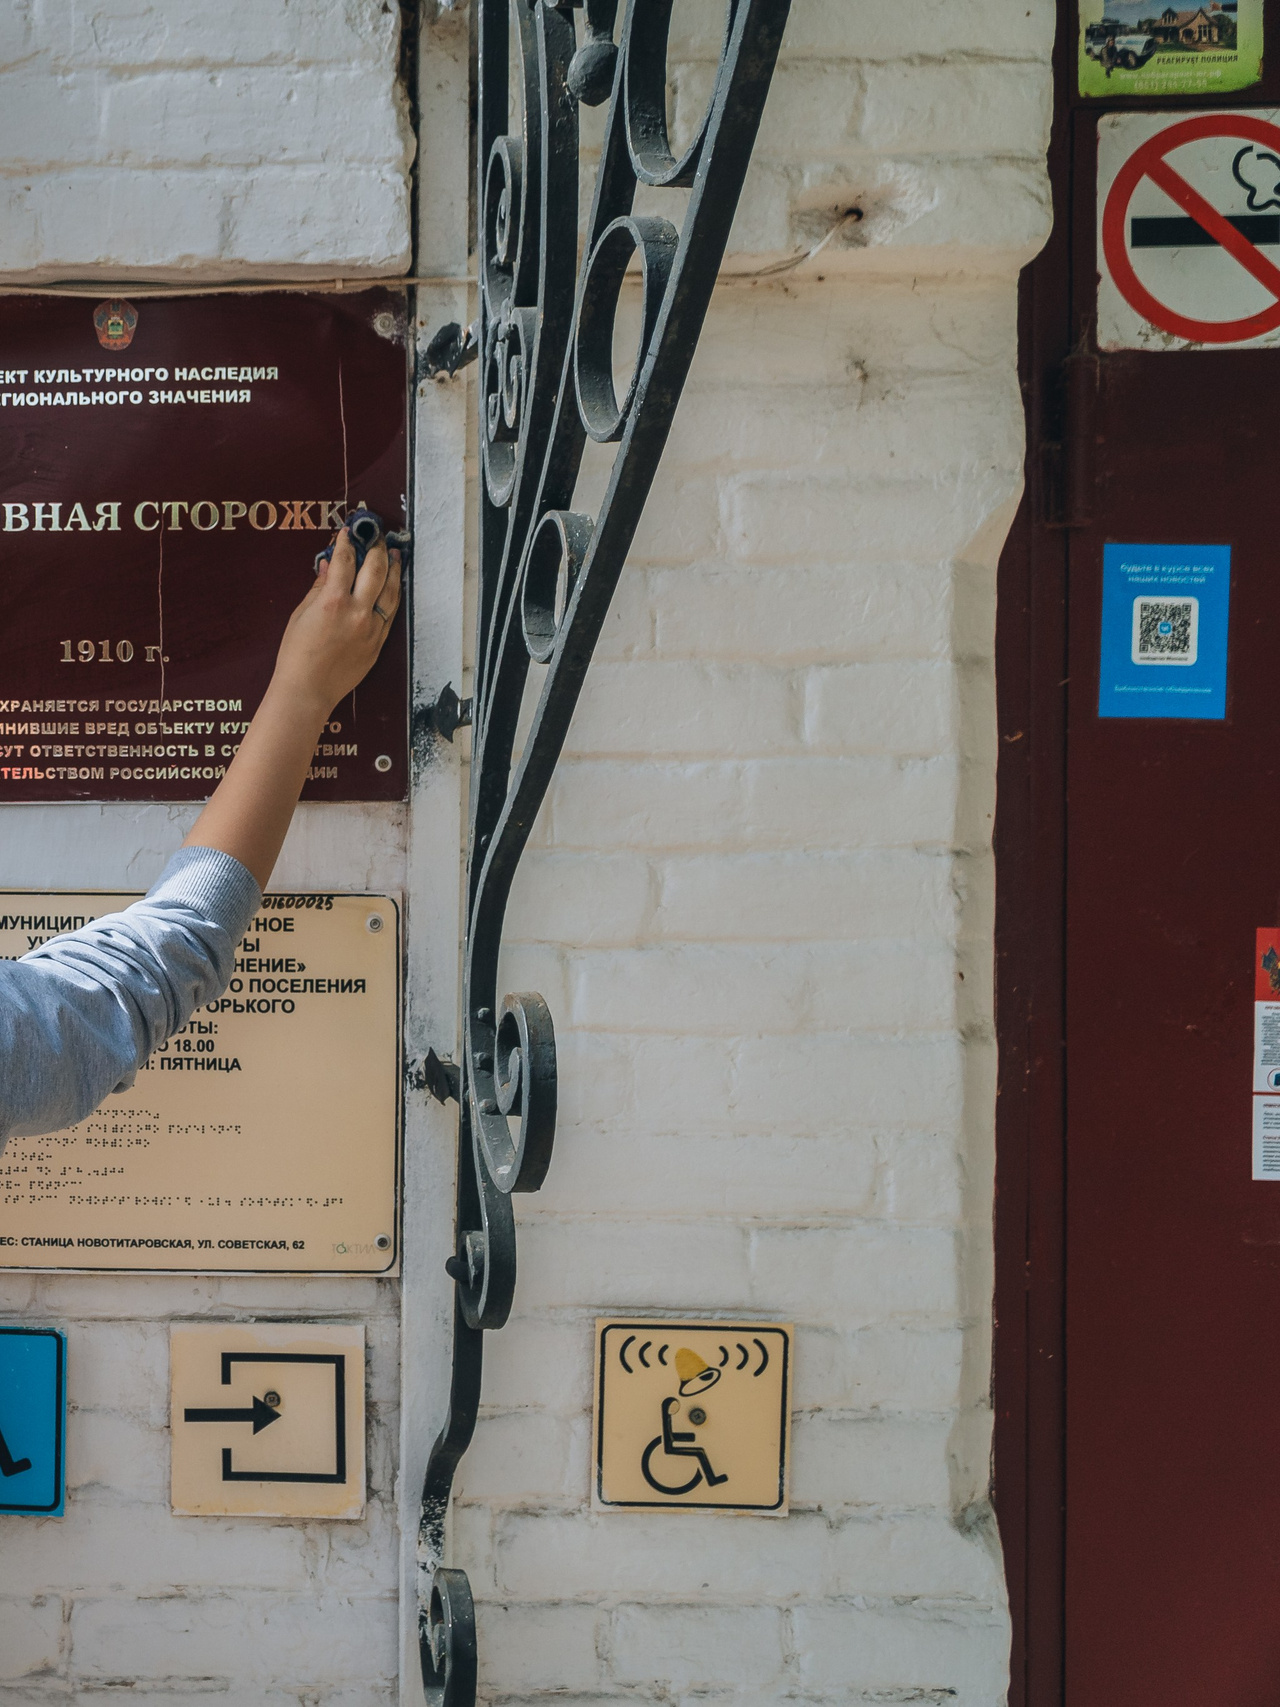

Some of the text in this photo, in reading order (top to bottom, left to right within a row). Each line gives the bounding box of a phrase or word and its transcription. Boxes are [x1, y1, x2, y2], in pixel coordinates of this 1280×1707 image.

[33, 367, 169, 384] КУЛЬТУРНОГО
[174, 366, 279, 383] НАСЛЕДИЯ
[148, 389, 251, 404] ЗНАЧЕНИЯ
[59, 639, 170, 663] 1910 г.
[105, 699, 243, 714] ГОСУДАРСТВОМ
[84, 722, 130, 736] ВРЕД
[134, 721, 216, 735] ОБЪЕКТУ
[29, 744, 200, 758] ОТВЕТСТВЕННОСТЬ
[204, 744, 216, 757] В
[109, 764, 226, 780] РОССИЙСКОЙ
[261, 896, 334, 911] 01600025
[249, 978, 367, 993] ПОСЕЛЕНИЯ
[196, 998, 296, 1013] ОРЬКОГО
[173, 1038, 215, 1053] 18.00
[160, 1056, 242, 1073] ПЯТНИЦА
[21, 1236, 75, 1248] СТАНИЦА
[77, 1238, 195, 1249] НОВОТИТАРОВСКАЯ,
[197, 1239, 215, 1249] УЛ.
[217, 1239, 289, 1250] СОВЕТСКАЯ,
[292, 1240, 305, 1249] 62
